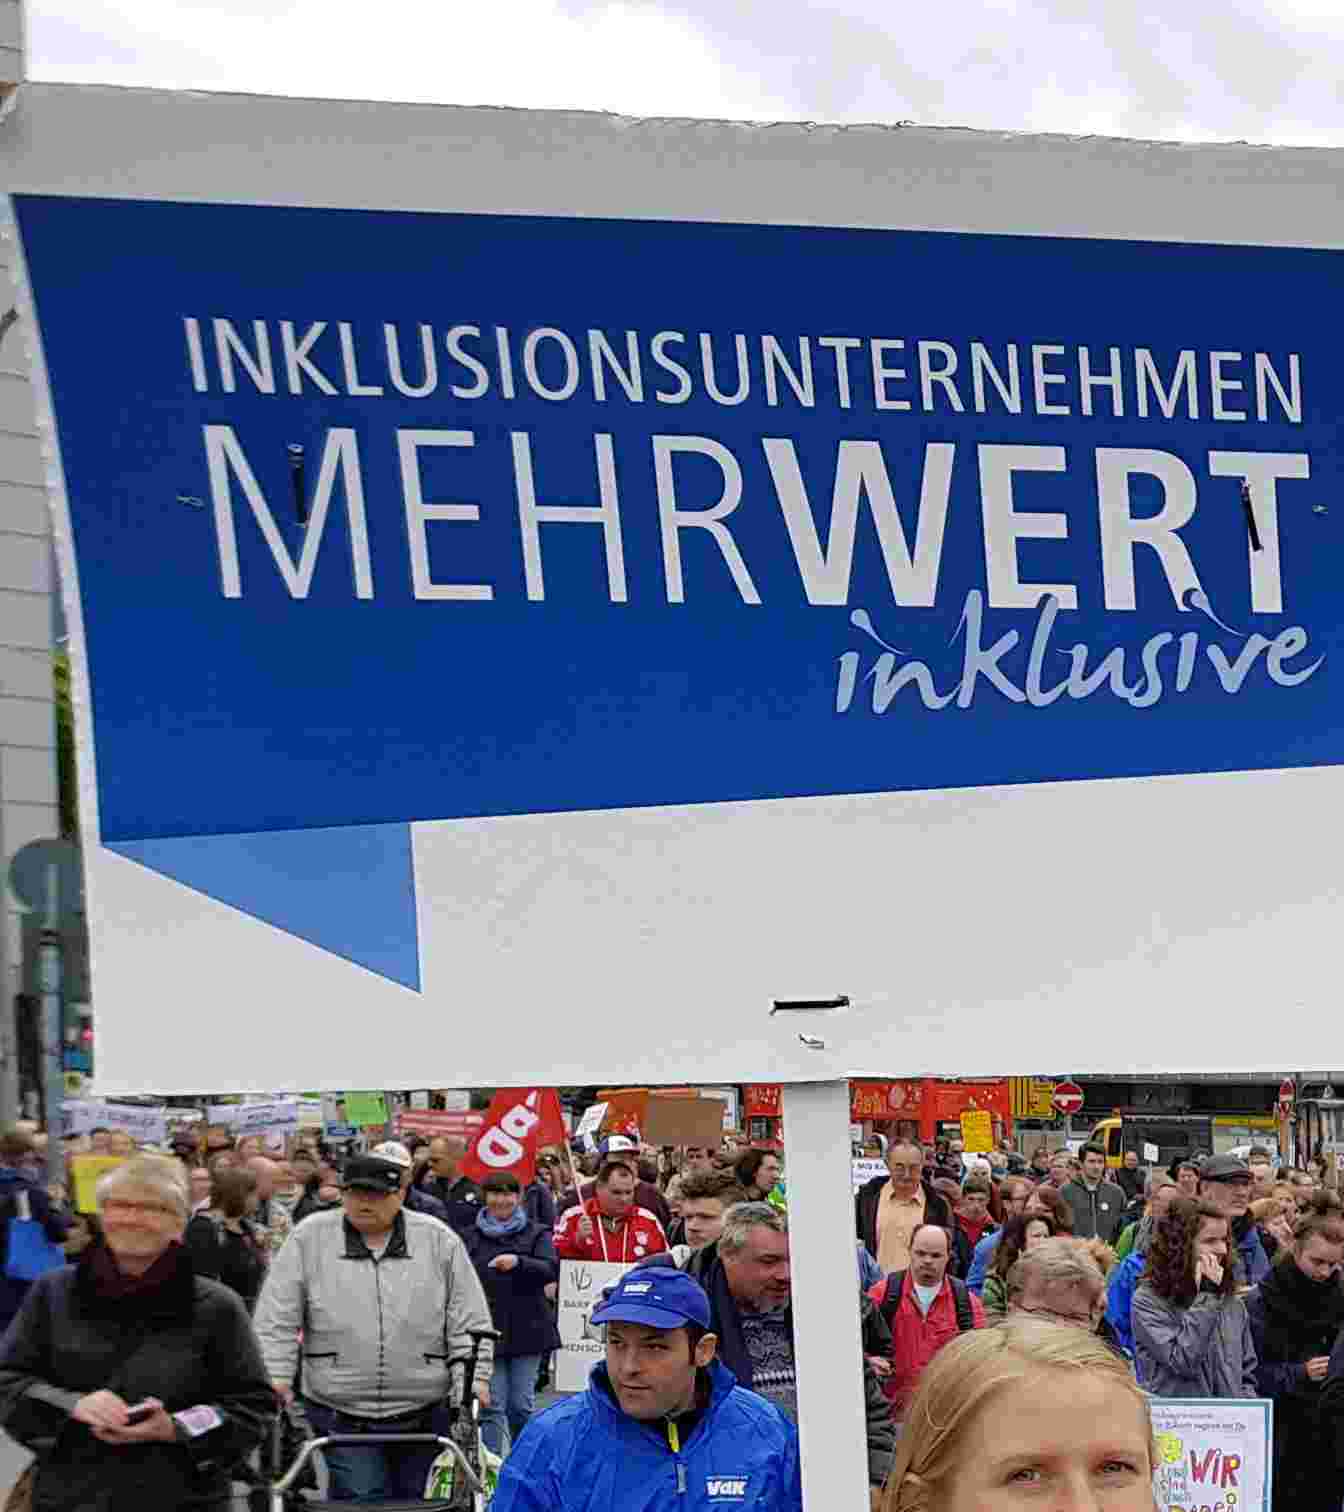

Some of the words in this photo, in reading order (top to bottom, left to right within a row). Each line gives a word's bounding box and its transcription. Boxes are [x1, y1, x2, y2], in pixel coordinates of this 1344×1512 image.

[184, 317, 1304, 425] INKLUSIONSUNTERNEHMEN
[202, 424, 1310, 614] MEHRWERT
[834, 586, 1326, 715] inklusive
